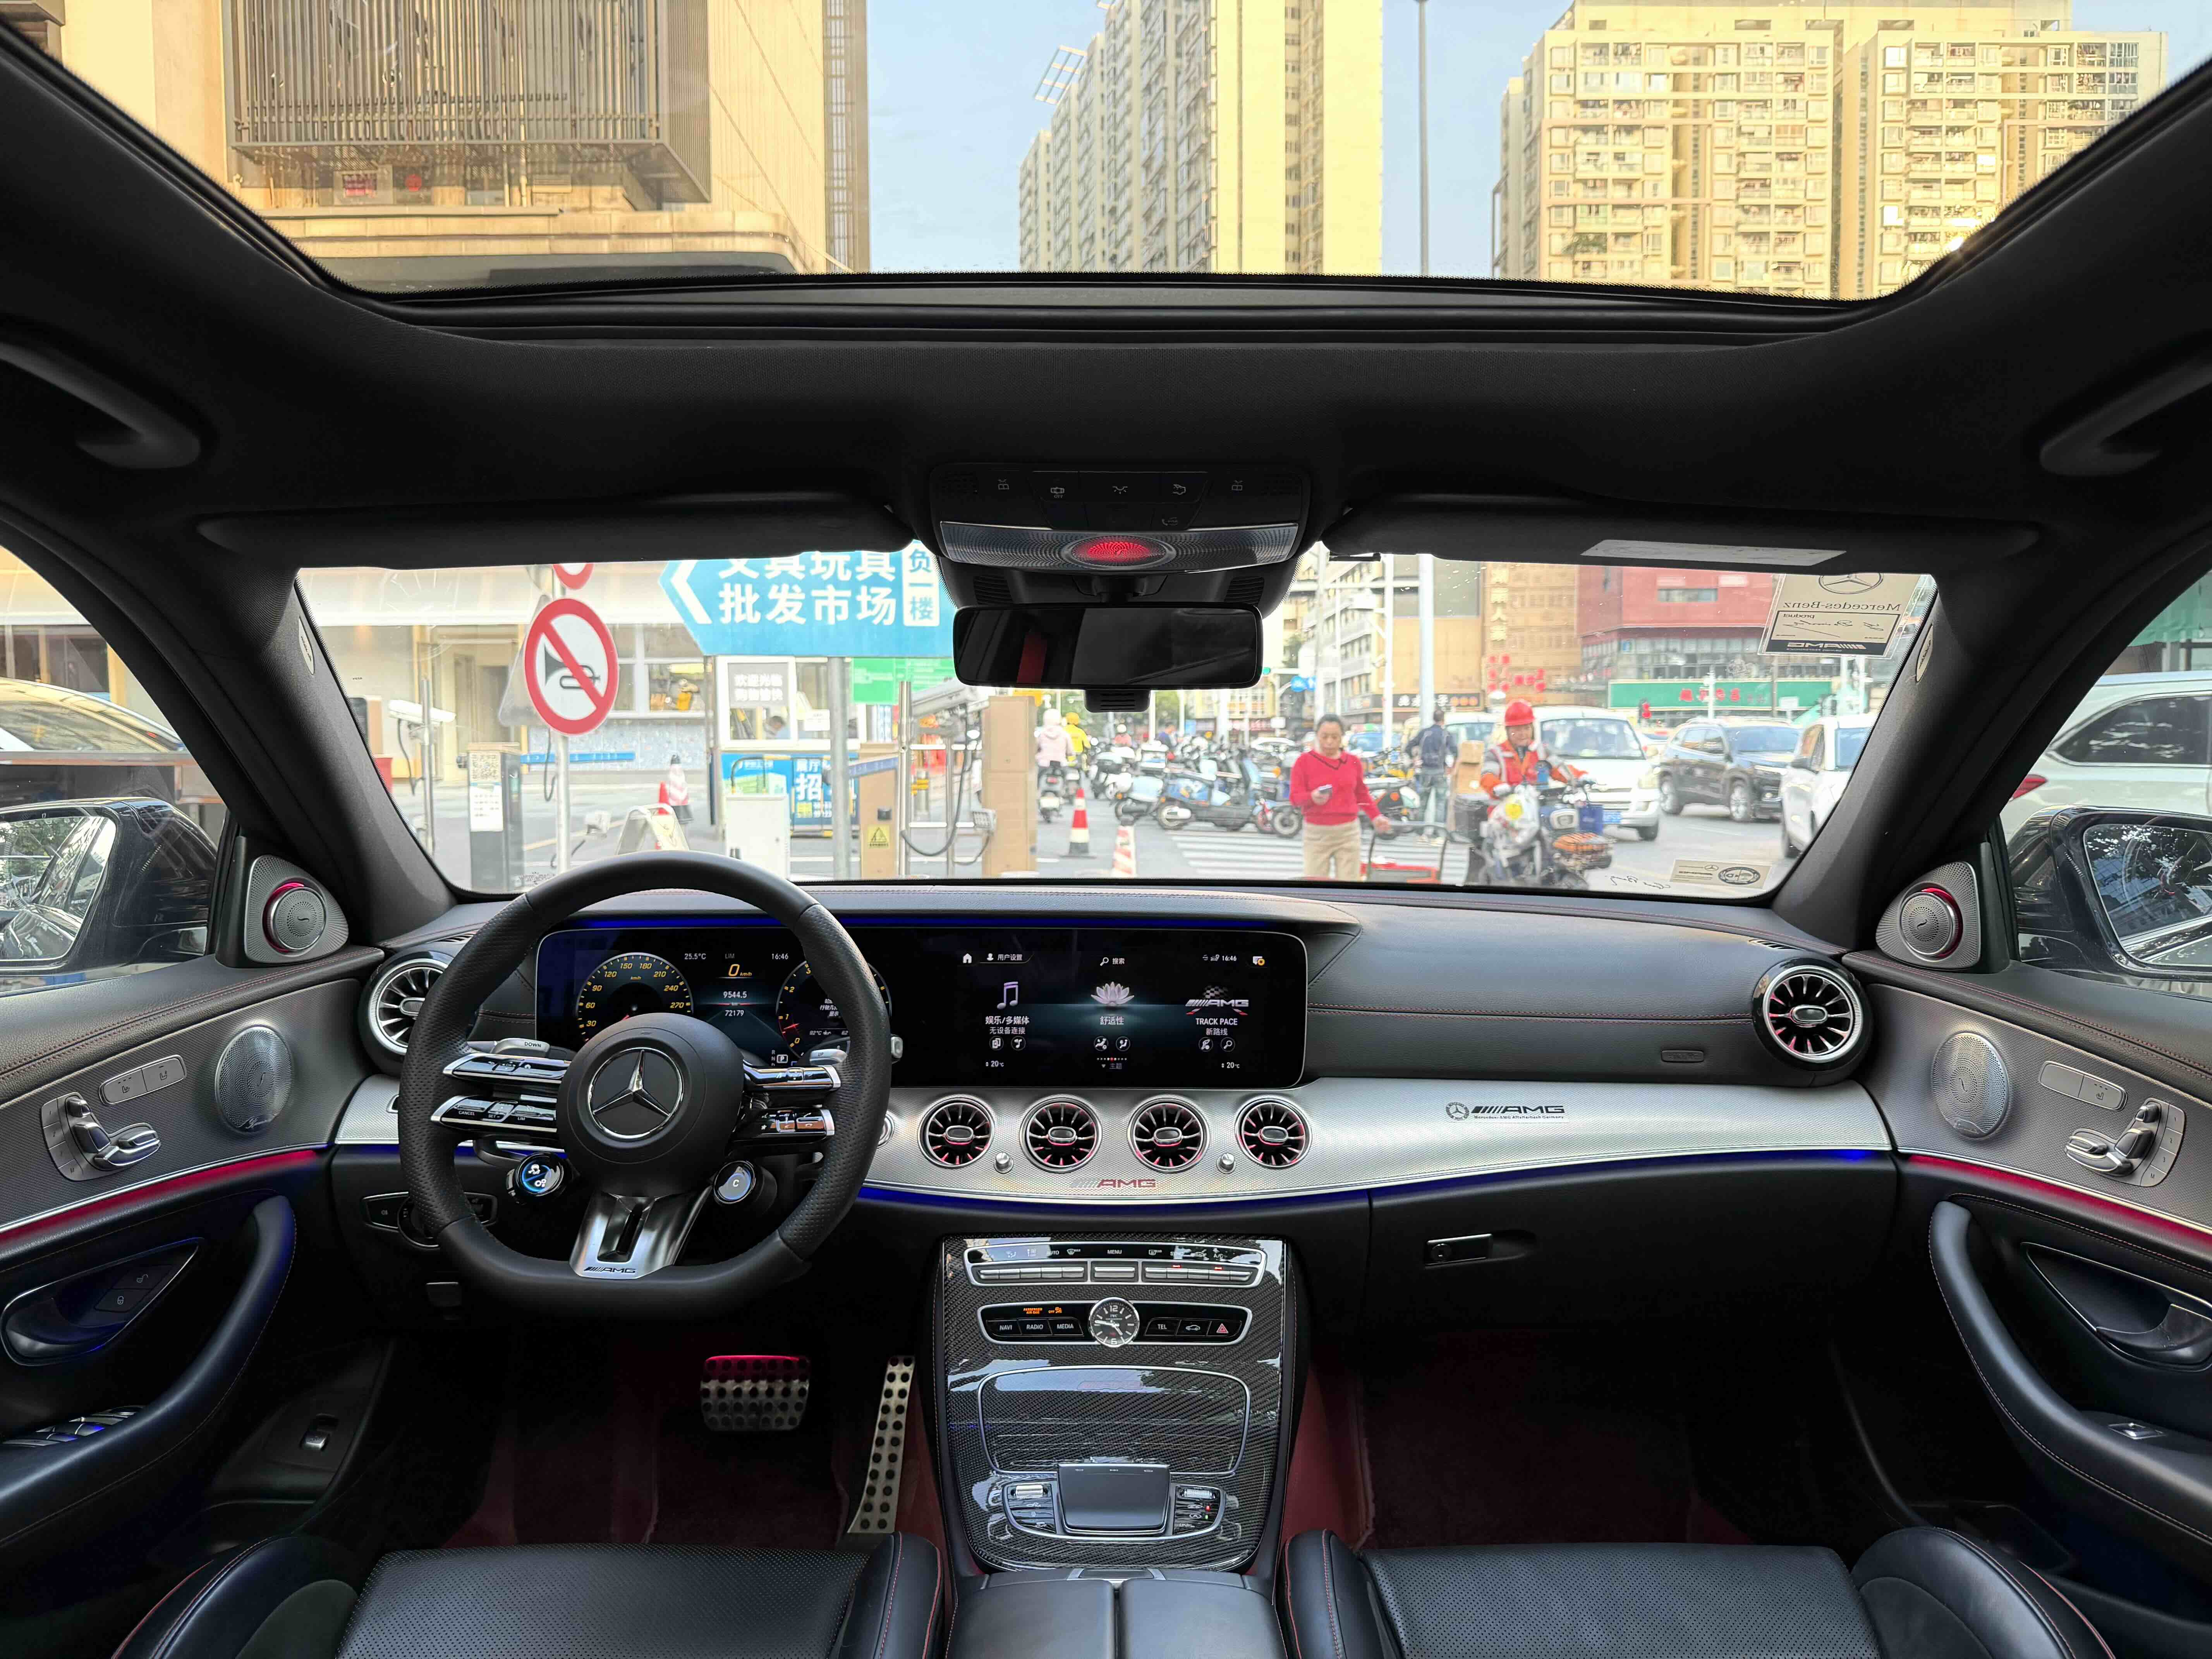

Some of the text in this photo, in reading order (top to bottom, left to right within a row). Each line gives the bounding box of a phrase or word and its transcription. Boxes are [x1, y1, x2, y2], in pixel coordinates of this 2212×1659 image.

[908, 548, 933, 620] 负一楼
[718, 582, 897, 625] 批发市场
[728, 963, 740, 976] 0
[985, 1016, 1030, 1025] 娱乐/多媒体
[1100, 1016, 1125, 1025] 舒适性
[1501, 1106, 1565, 1114] AMG
[1097, 1179, 1156, 1188] AMG
